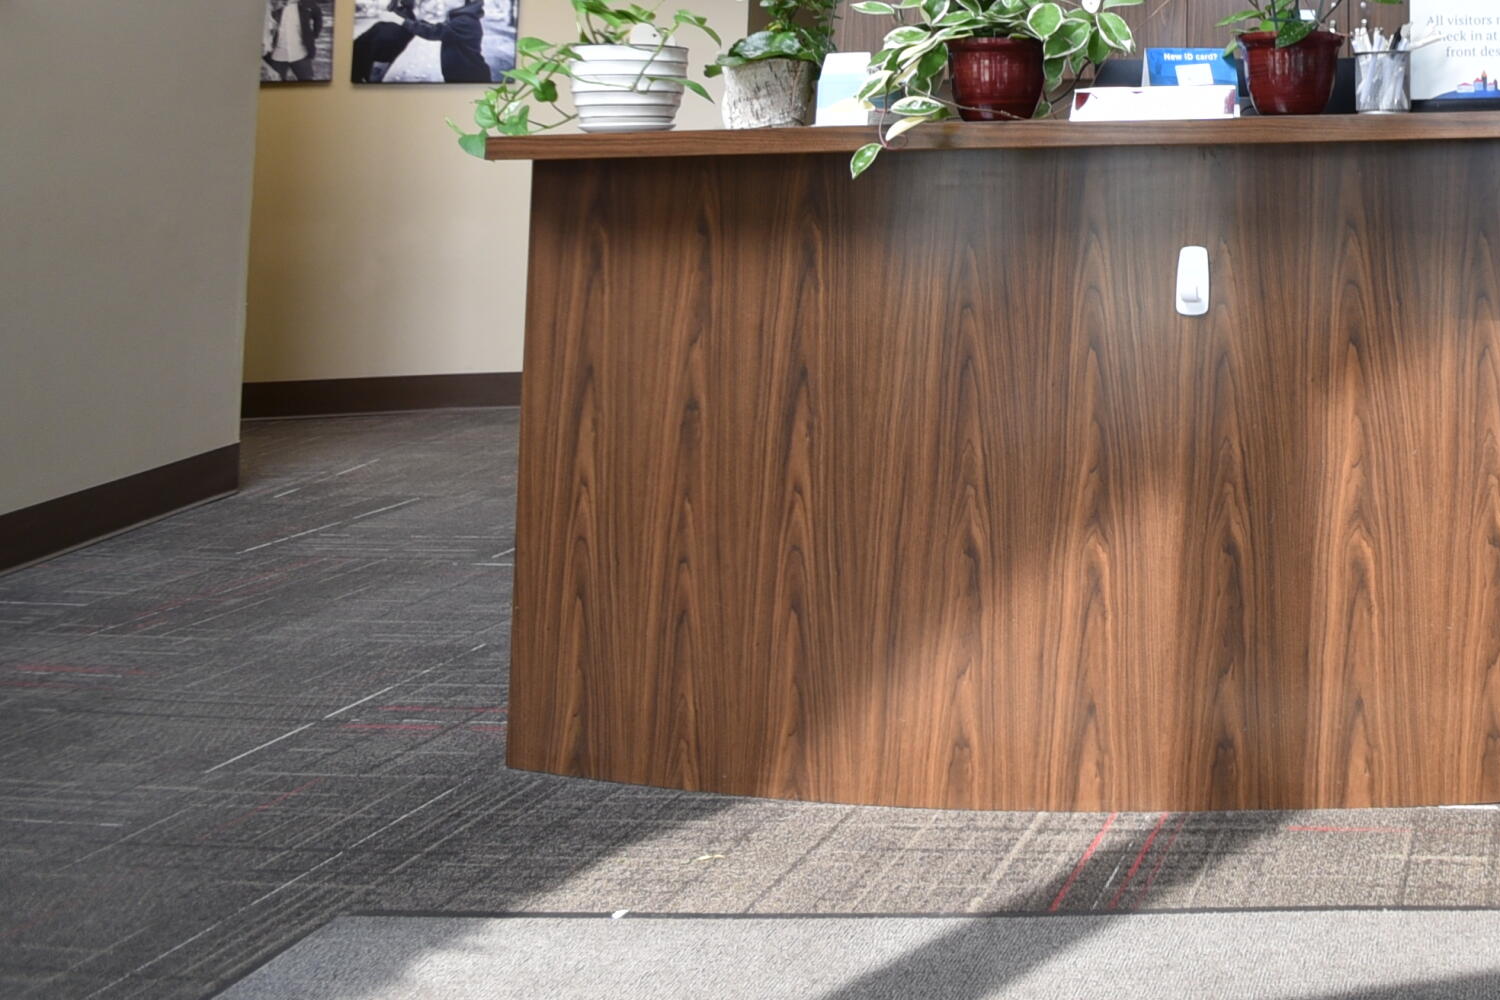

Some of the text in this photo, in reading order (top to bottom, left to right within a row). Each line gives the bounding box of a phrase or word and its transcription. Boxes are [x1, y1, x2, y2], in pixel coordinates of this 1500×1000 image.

[1426, 15, 1444, 26] All
[1447, 15, 1493, 25] visitors
[1470, 31, 1482, 41] in
[1486, 31, 1497, 41] at
[1163, 52, 1217, 61] New ID card?
[1446, 46, 1476, 58] front
